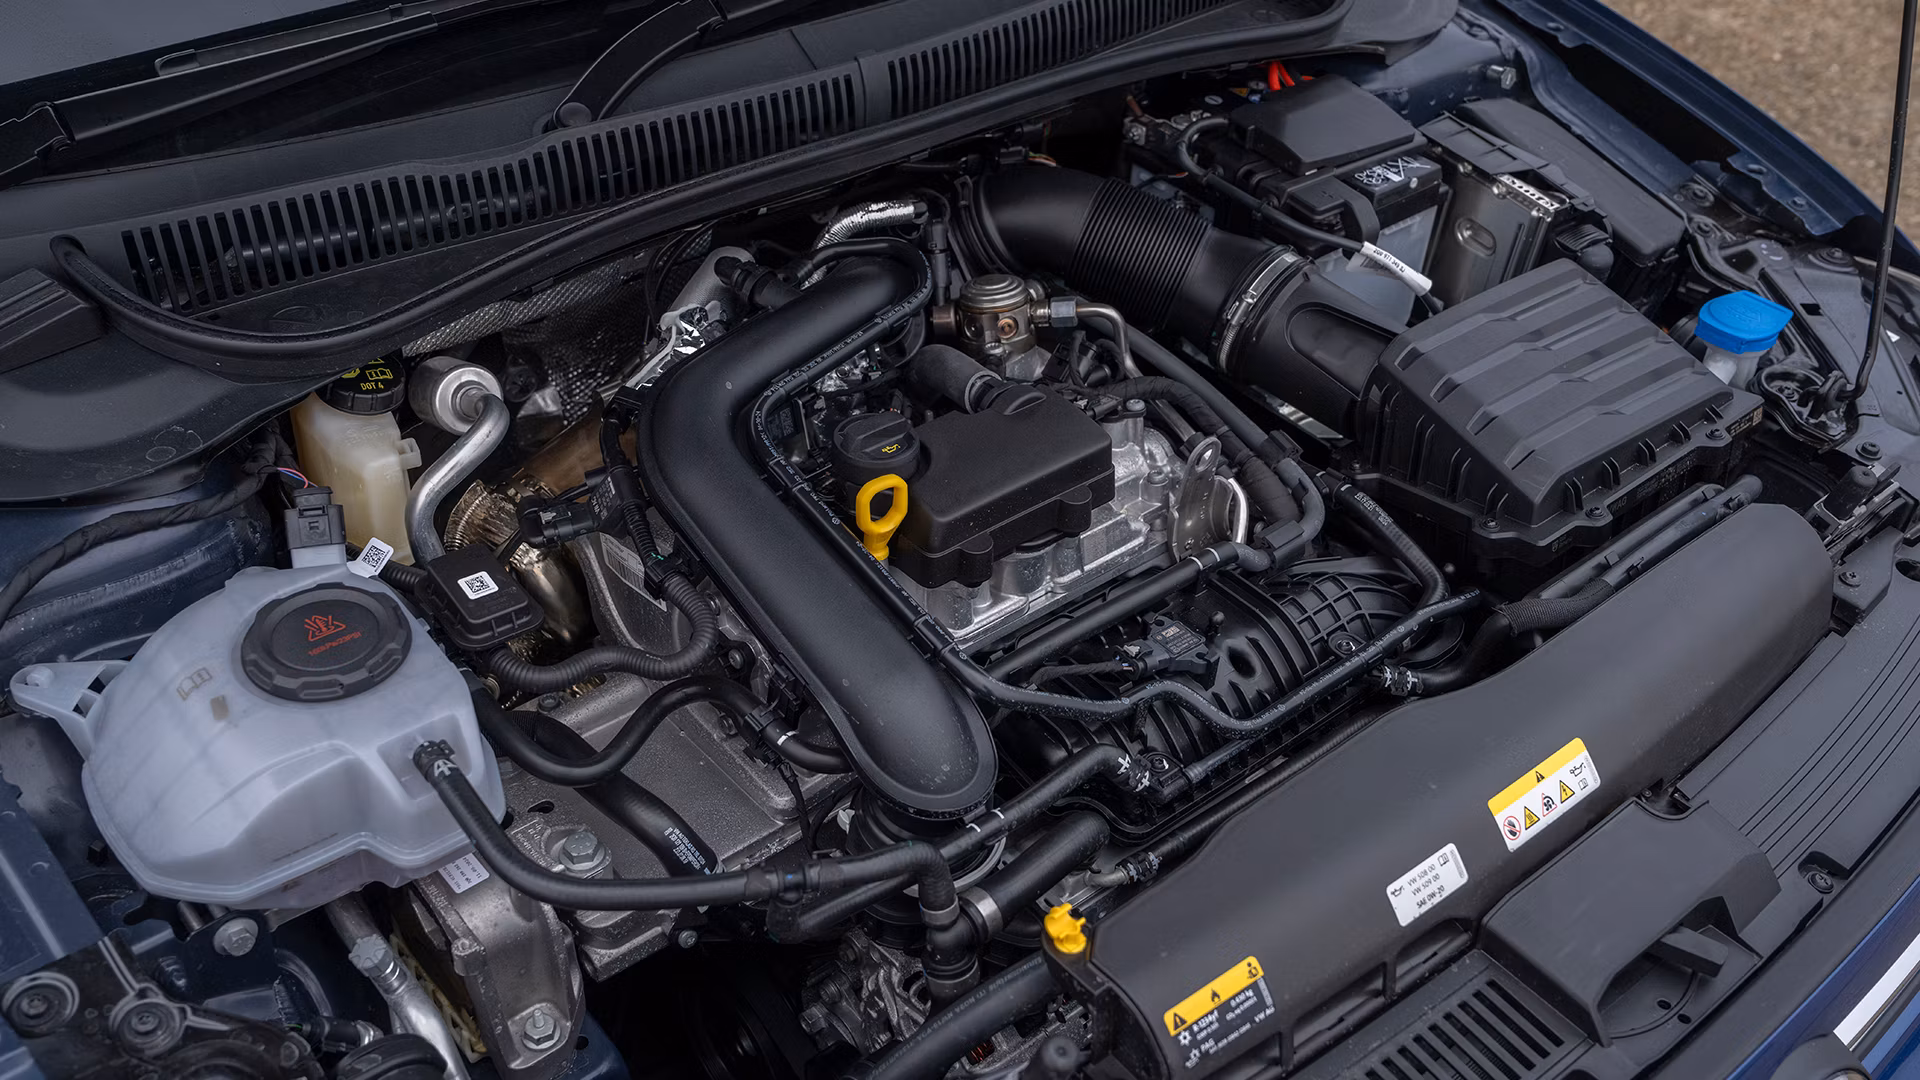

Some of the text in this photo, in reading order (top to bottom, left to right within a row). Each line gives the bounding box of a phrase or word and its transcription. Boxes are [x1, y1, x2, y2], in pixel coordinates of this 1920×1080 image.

[359, 381, 376, 390] DOT
[1407, 864, 1435, 886] VW 508 00
[1412, 873, 1440, 896] VW 509 00
[1416, 885, 1444, 908] SAE 0W-20
[1254, 1005, 1275, 1023] VW AG
[1200, 1038, 1215, 1053] PAG
